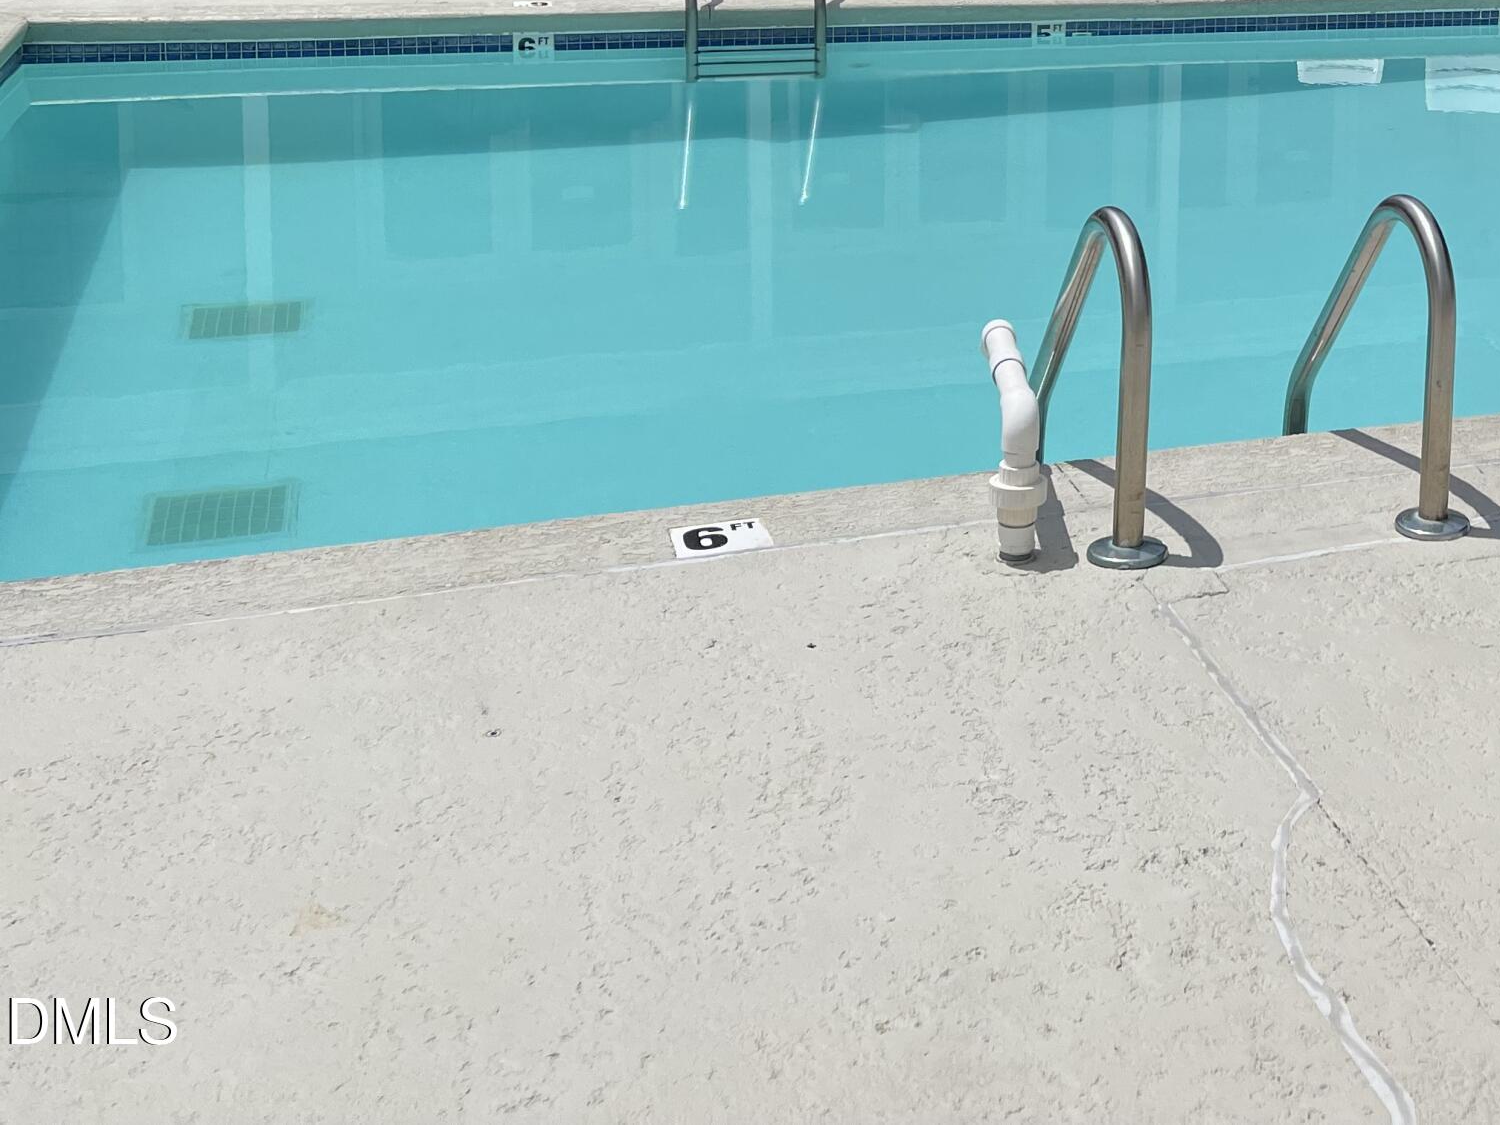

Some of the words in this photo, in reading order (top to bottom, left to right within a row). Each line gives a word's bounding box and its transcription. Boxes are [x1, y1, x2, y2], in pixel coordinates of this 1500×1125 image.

[1037, 24, 1051, 37] 5
[1053, 24, 1062, 32] FT
[518, 37, 535, 51] 6
[538, 36, 549, 45] FT
[682, 526, 728, 551] 6
[729, 521, 756, 531] FT
